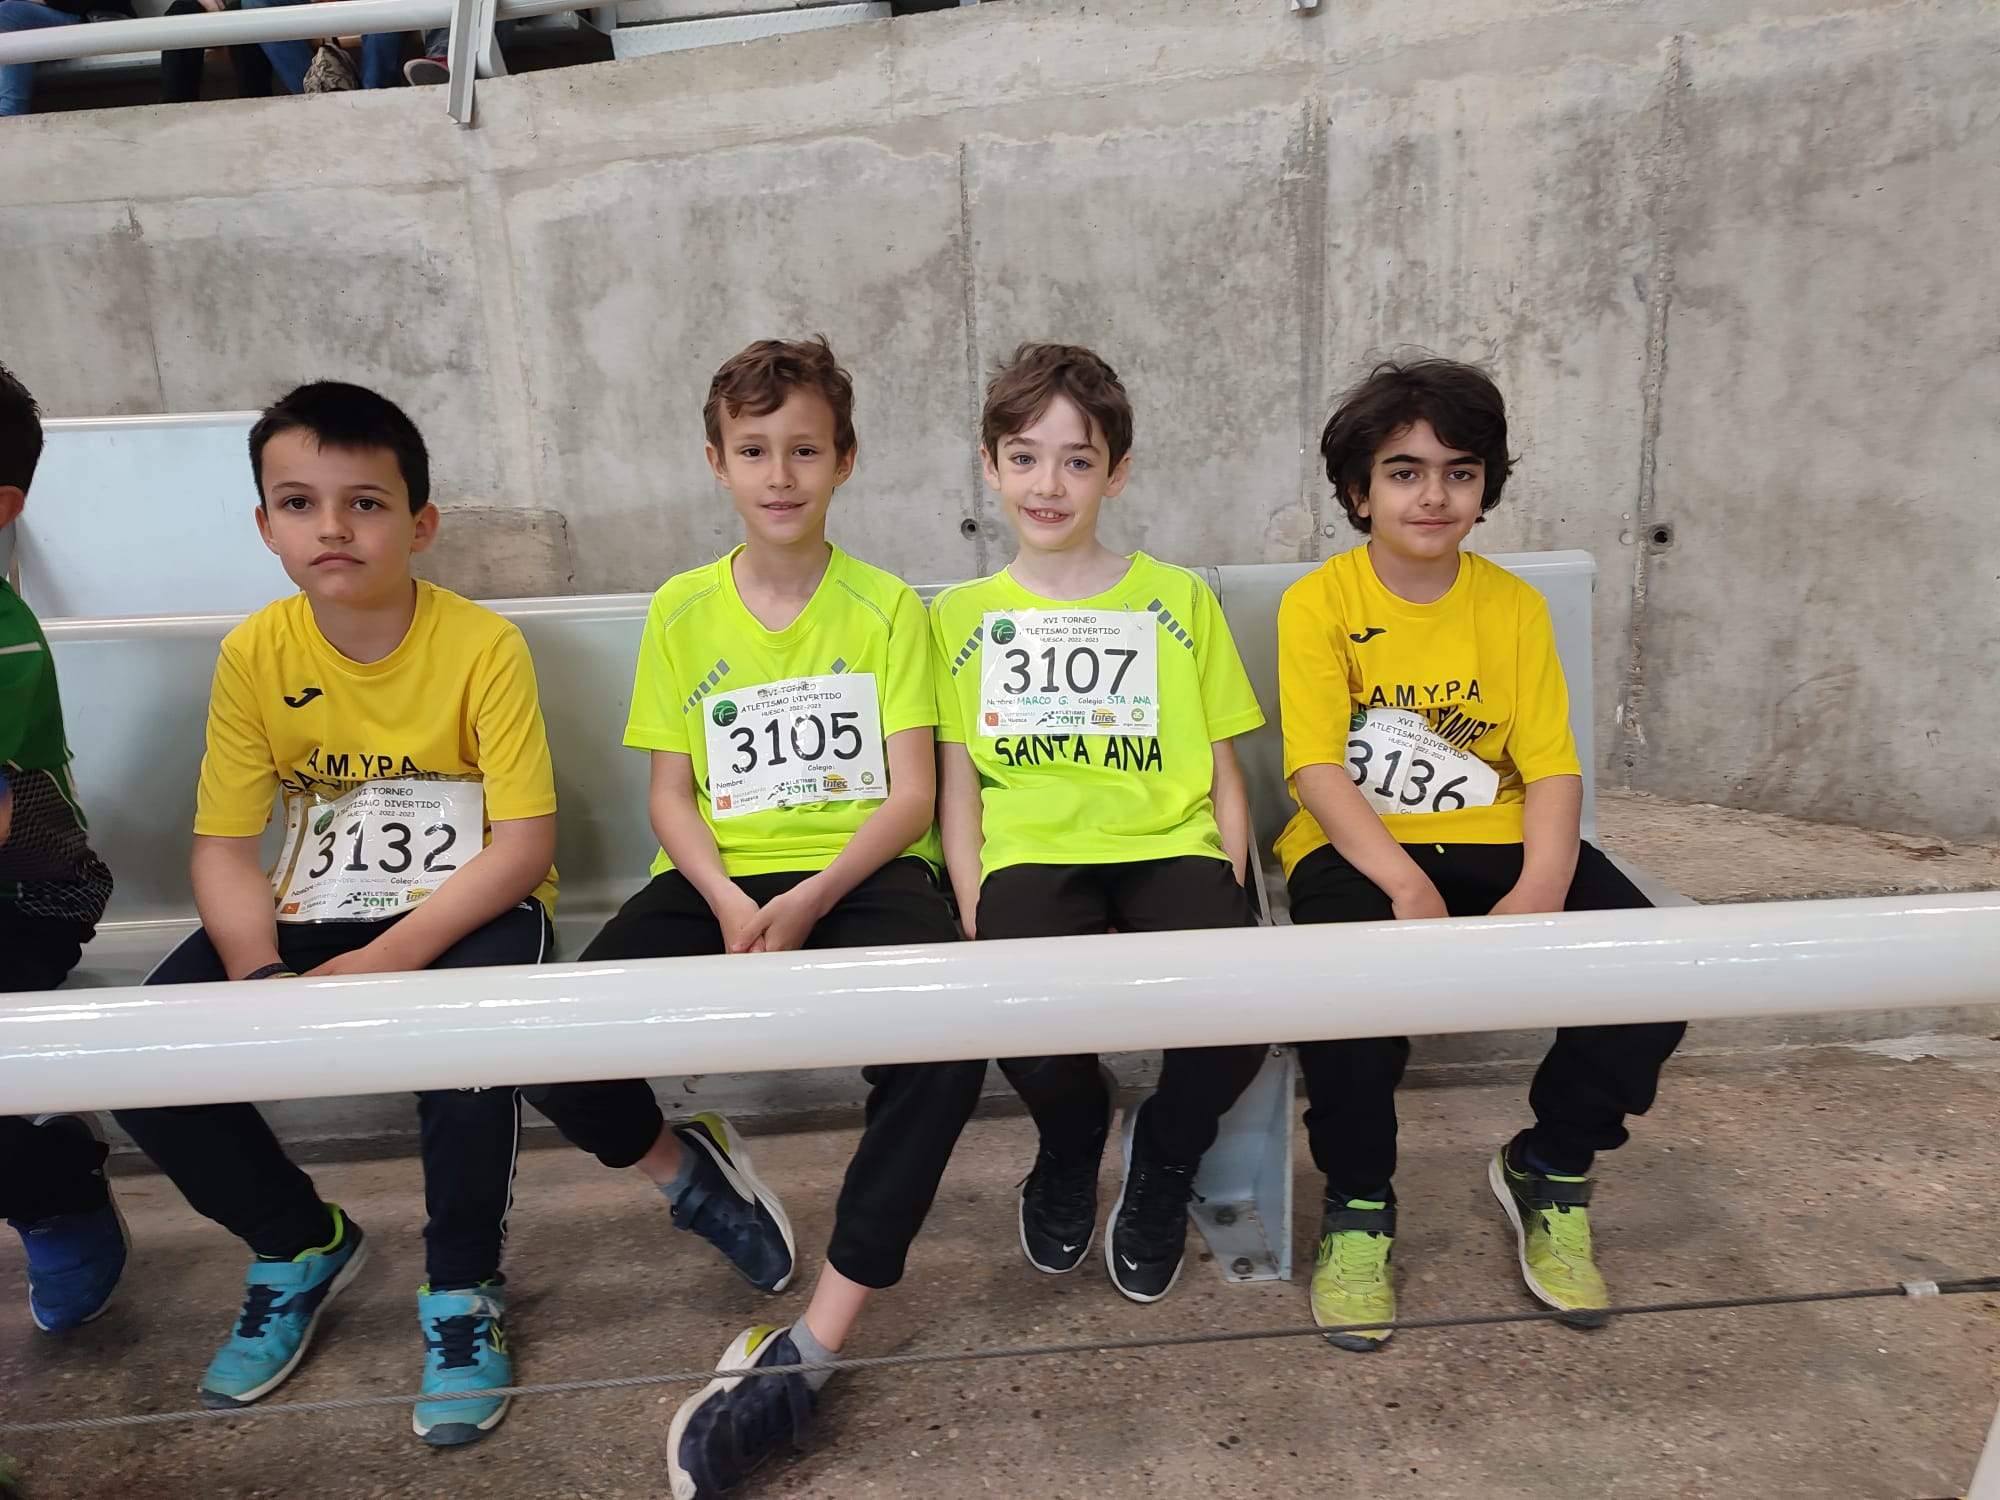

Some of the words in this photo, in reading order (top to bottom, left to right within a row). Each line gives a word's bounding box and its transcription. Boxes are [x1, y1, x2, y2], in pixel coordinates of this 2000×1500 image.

[1019, 627, 1069, 635] TLETISMO
[1072, 627, 1121, 635] DIVERTIDO
[1062, 616, 1097, 624] TORNEO
[1003, 647, 1138, 695] 3107
[741, 697, 790, 714] ATLETISMO
[1017, 696, 1052, 705] MARCO
[1132, 696, 1152, 705] ANA
[730, 711, 862, 774] 3105
[995, 734, 1091, 766] SANTA
[1103, 735, 1163, 772] ANA
[1369, 721, 1422, 742] ATLETISMO
[1422, 736, 1469, 761] DIVERTIDO
[1347, 739, 1468, 812] 3136
[372, 787, 414, 796] TORNEO
[384, 799, 441, 809] DIVERTIDO
[309, 822, 457, 879] 3132
